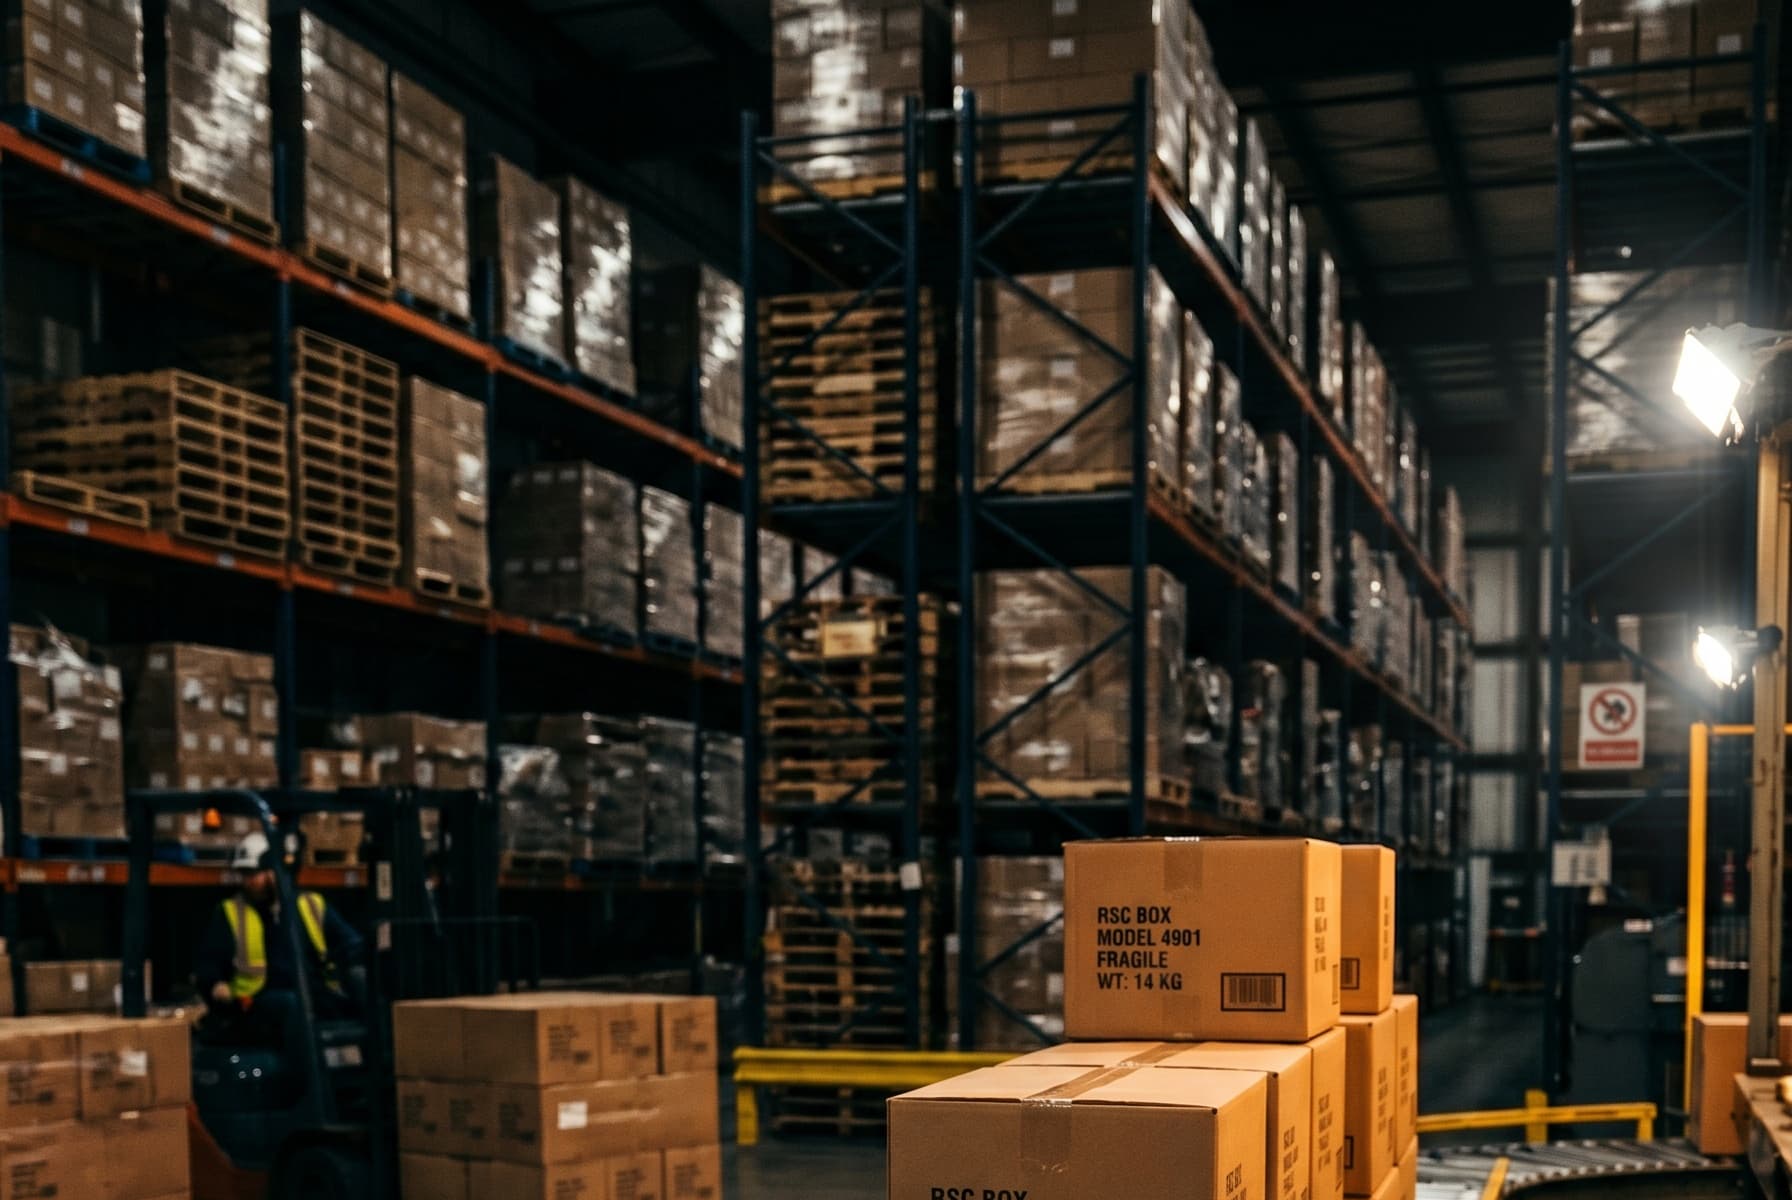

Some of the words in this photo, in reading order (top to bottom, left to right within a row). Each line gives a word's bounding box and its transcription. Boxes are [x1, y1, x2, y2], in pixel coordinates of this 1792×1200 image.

[1097, 906, 1131, 924] RSC
[1136, 906, 1171, 924] BOX
[1097, 929, 1156, 947] MODEL
[1161, 929, 1201, 947] 4901
[1097, 950, 1168, 969] FRAGILE
[1097, 972, 1129, 991] WT:
[1134, 972, 1153, 991] 14
[1159, 972, 1182, 991] KG
